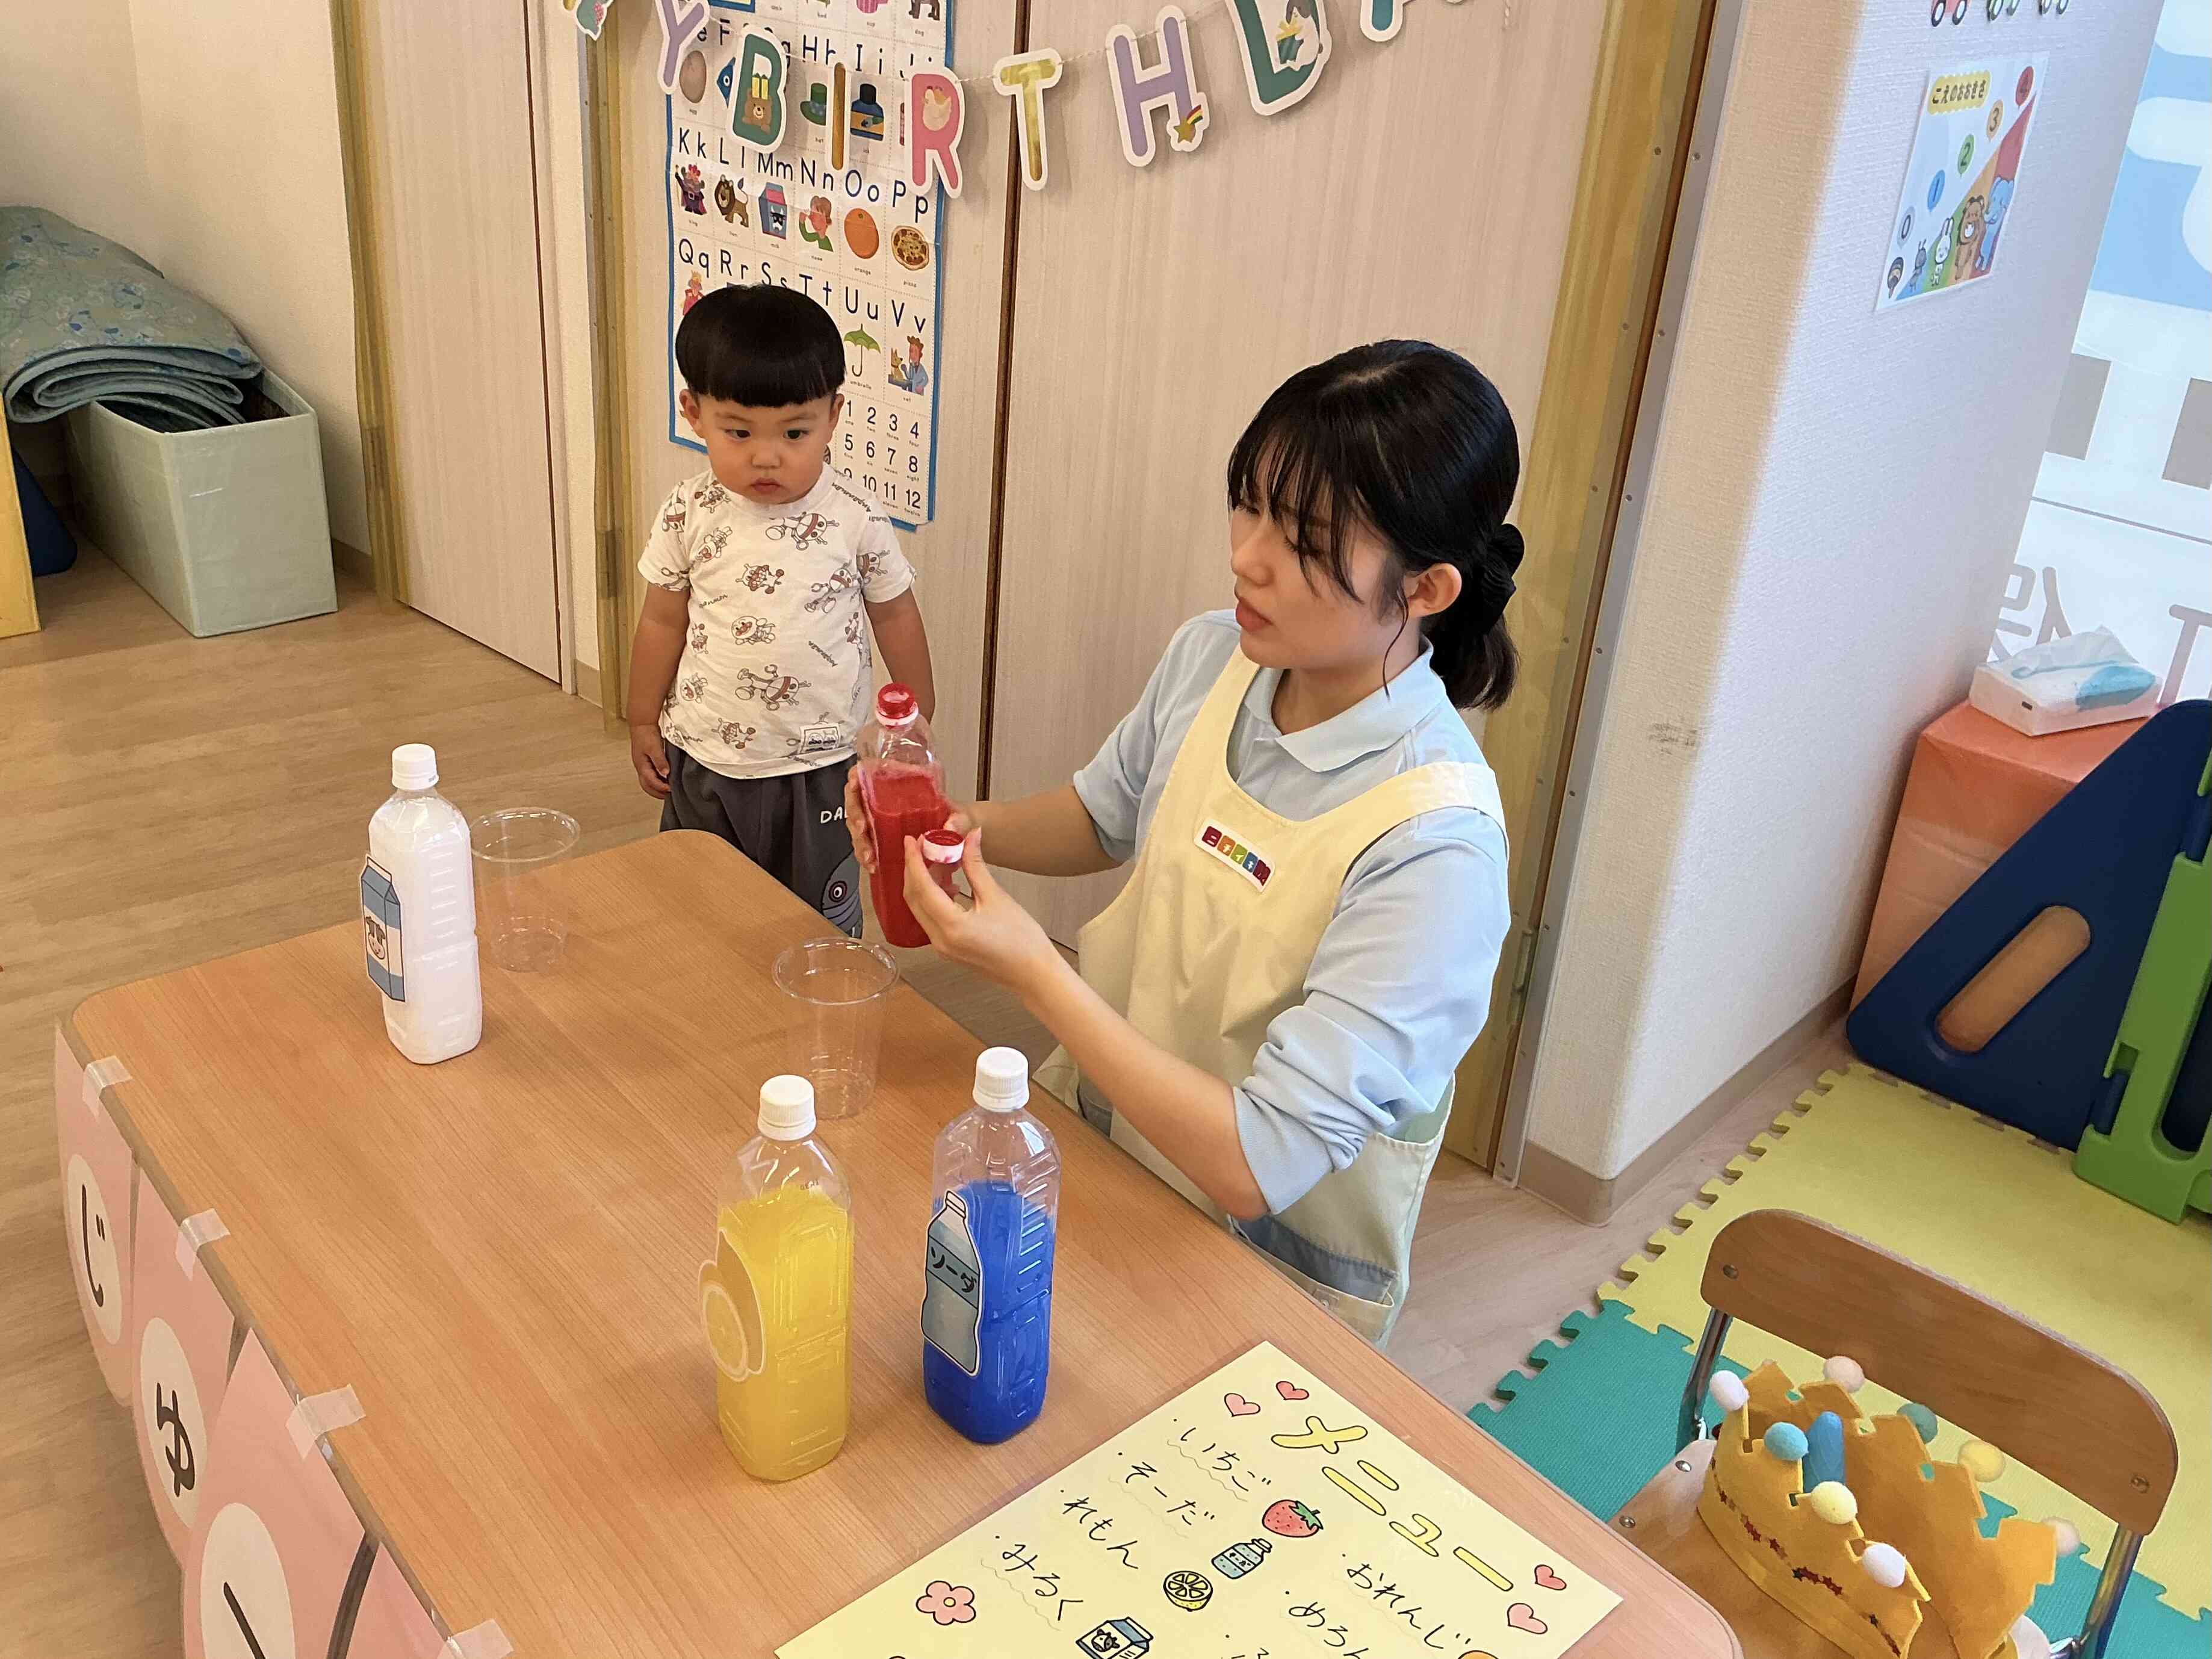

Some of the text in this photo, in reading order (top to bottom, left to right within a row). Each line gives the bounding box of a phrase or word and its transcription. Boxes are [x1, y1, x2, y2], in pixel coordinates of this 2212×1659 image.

[1990, 107, 1999, 130] 3
[1960, 143, 1971, 167] 2
[847, 400, 919, 439] 1 2 3 4
[844, 433, 918, 473] 5 6 7 8
[863, 474, 877, 492] 10
[884, 481, 896, 501] 11
[905, 489, 921, 509] 12
[931, 1246, 977, 1294] ソーダ
[1271, 1416, 1514, 1592] メニュー
